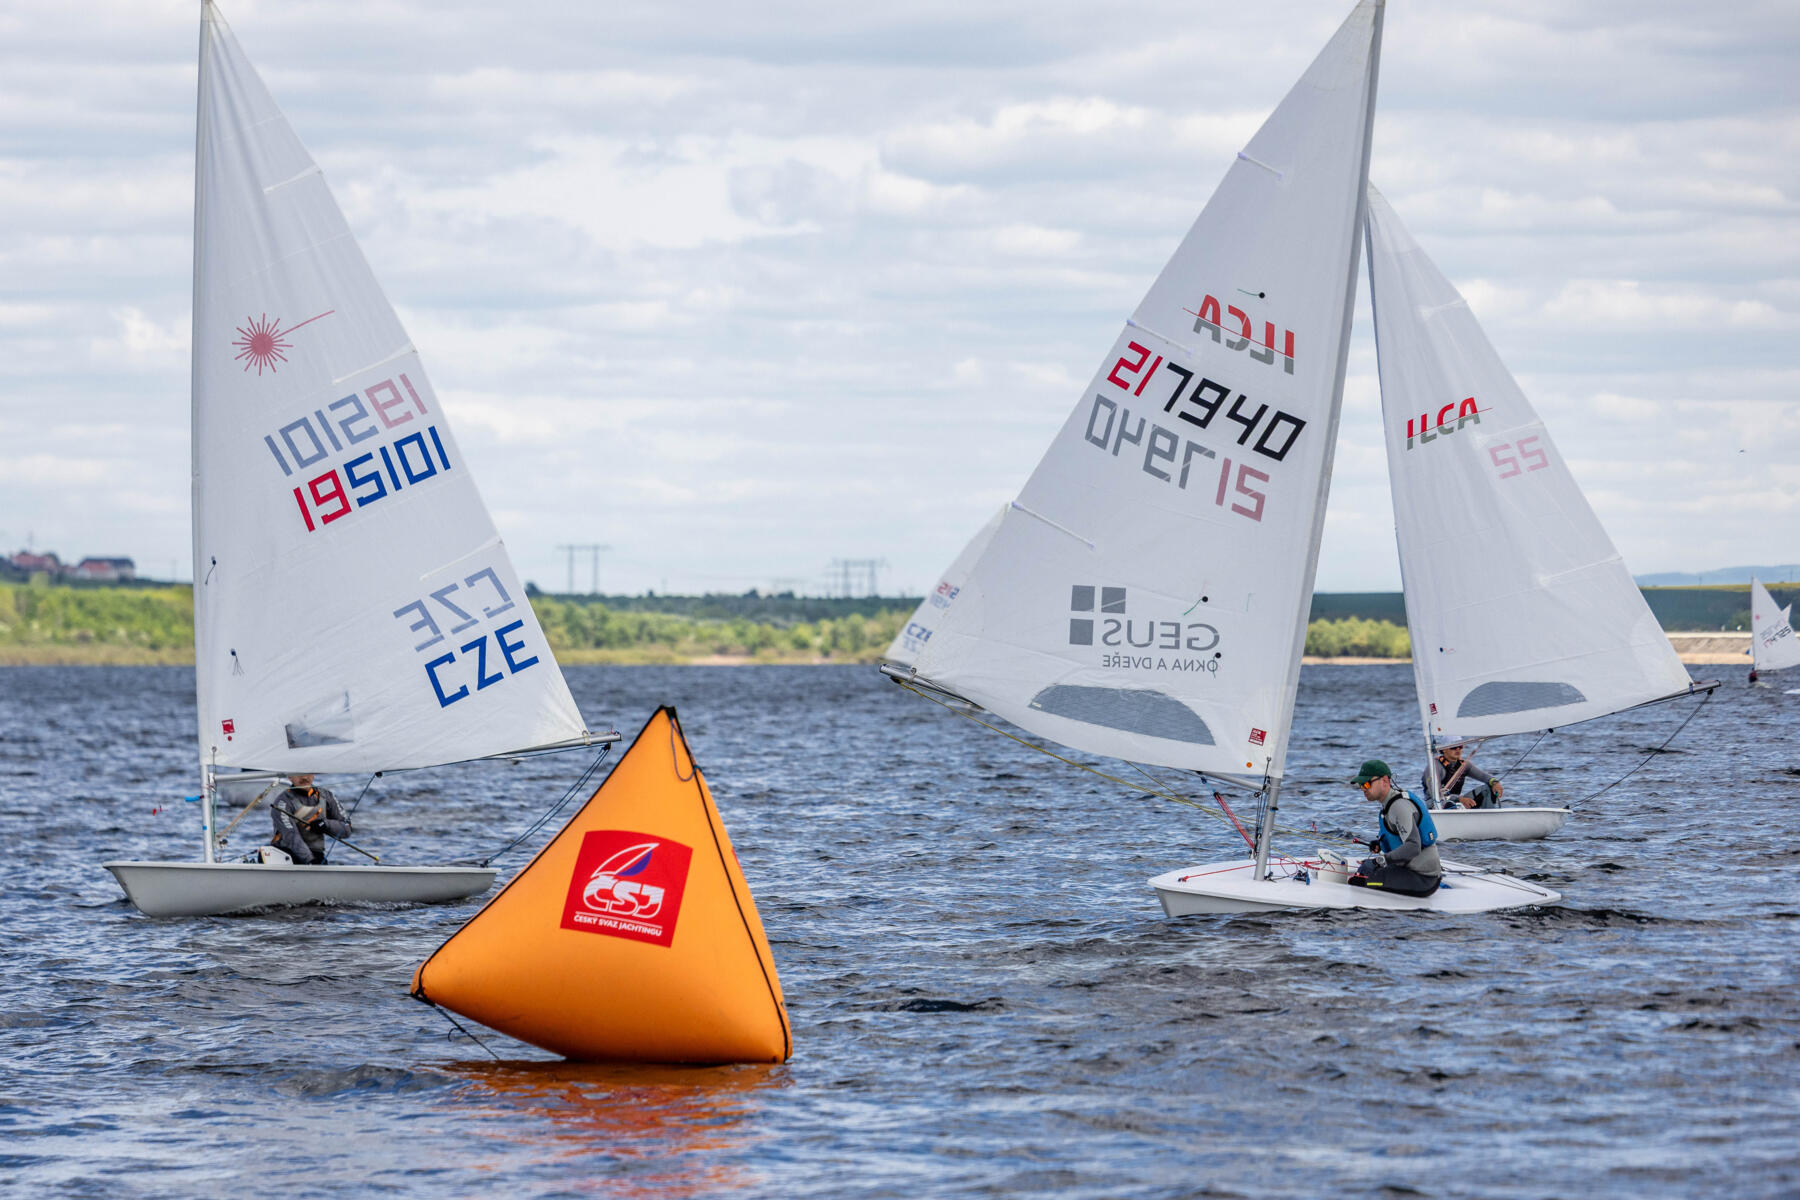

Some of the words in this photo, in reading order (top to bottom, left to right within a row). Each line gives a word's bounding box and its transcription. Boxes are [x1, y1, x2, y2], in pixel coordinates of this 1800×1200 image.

[1106, 340, 1308, 462] 217940
[1406, 396, 1481, 451] ILCA
[292, 425, 452, 533] 195101
[424, 619, 540, 709] CZE
[598, 918, 619, 928] SVAZ
[618, 921, 663, 937] JACHTINGU
